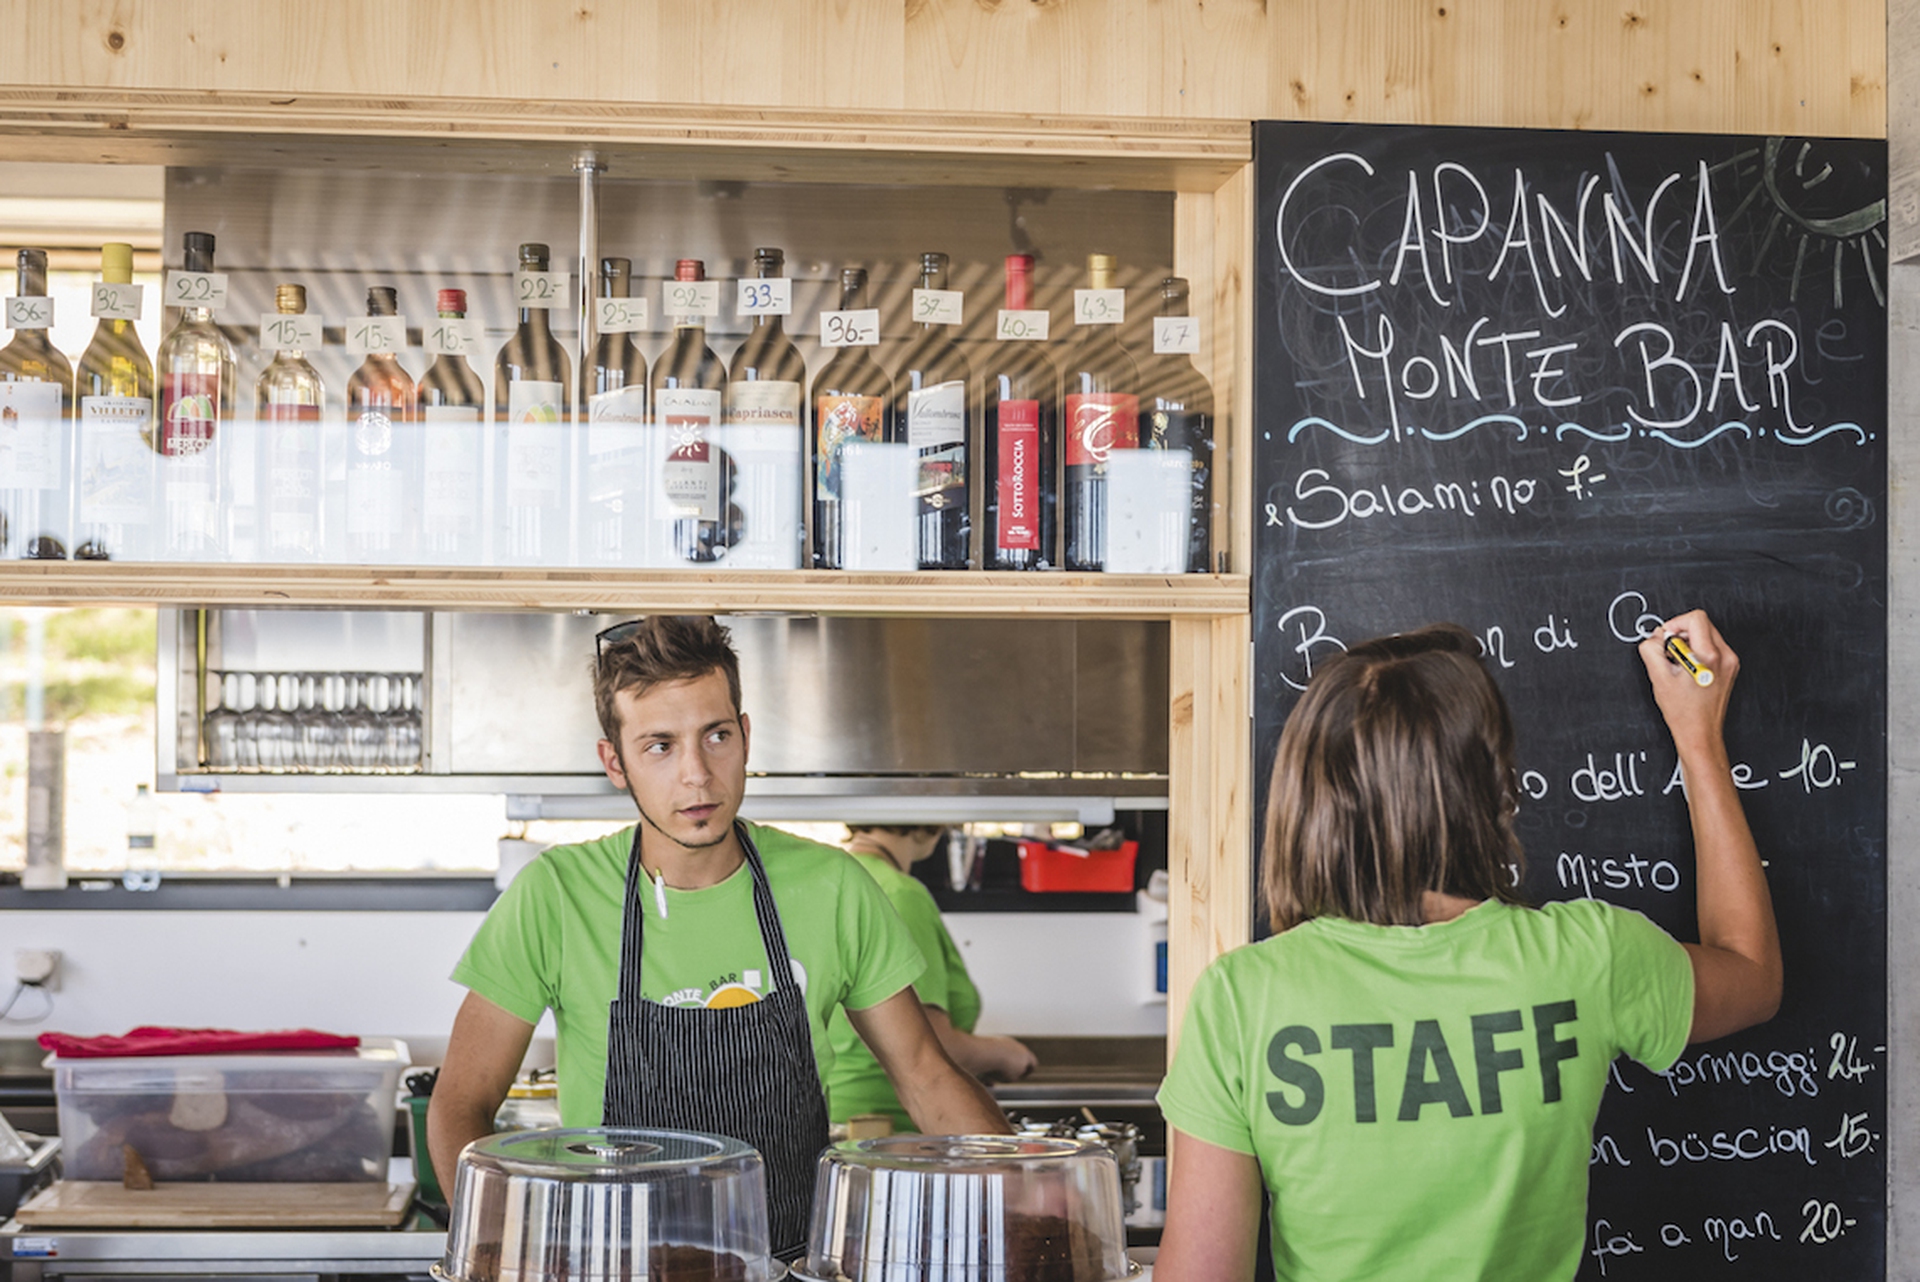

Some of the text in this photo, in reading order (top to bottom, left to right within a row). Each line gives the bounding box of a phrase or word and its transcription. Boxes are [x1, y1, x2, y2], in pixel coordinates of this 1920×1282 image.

[1277, 152, 1737, 318] CAPANNA
[520, 277, 563, 300] 22.-
[744, 283, 783, 308] 33.-
[266, 320, 312, 345] 15.-
[603, 302, 644, 326] 25.-
[827, 316, 874, 343] 36.-
[431, 326, 474, 351] 15.-
[1337, 313, 1583, 443] MONTE
[1614, 318, 1815, 434] BAR
[1011, 438, 1024, 519] SOTTOROCCIA
[1286, 468, 1537, 529] Salamino
[1534, 614, 1578, 654] di
[1570, 752, 1648, 802] dell'
[709, 972, 738, 991] BAR
[1265, 998, 1579, 1126] STAFF
[1660, 1223, 1692, 1247] a
[1704, 1211, 1782, 1262] man
[1799, 1199, 1857, 1244] 20.-
